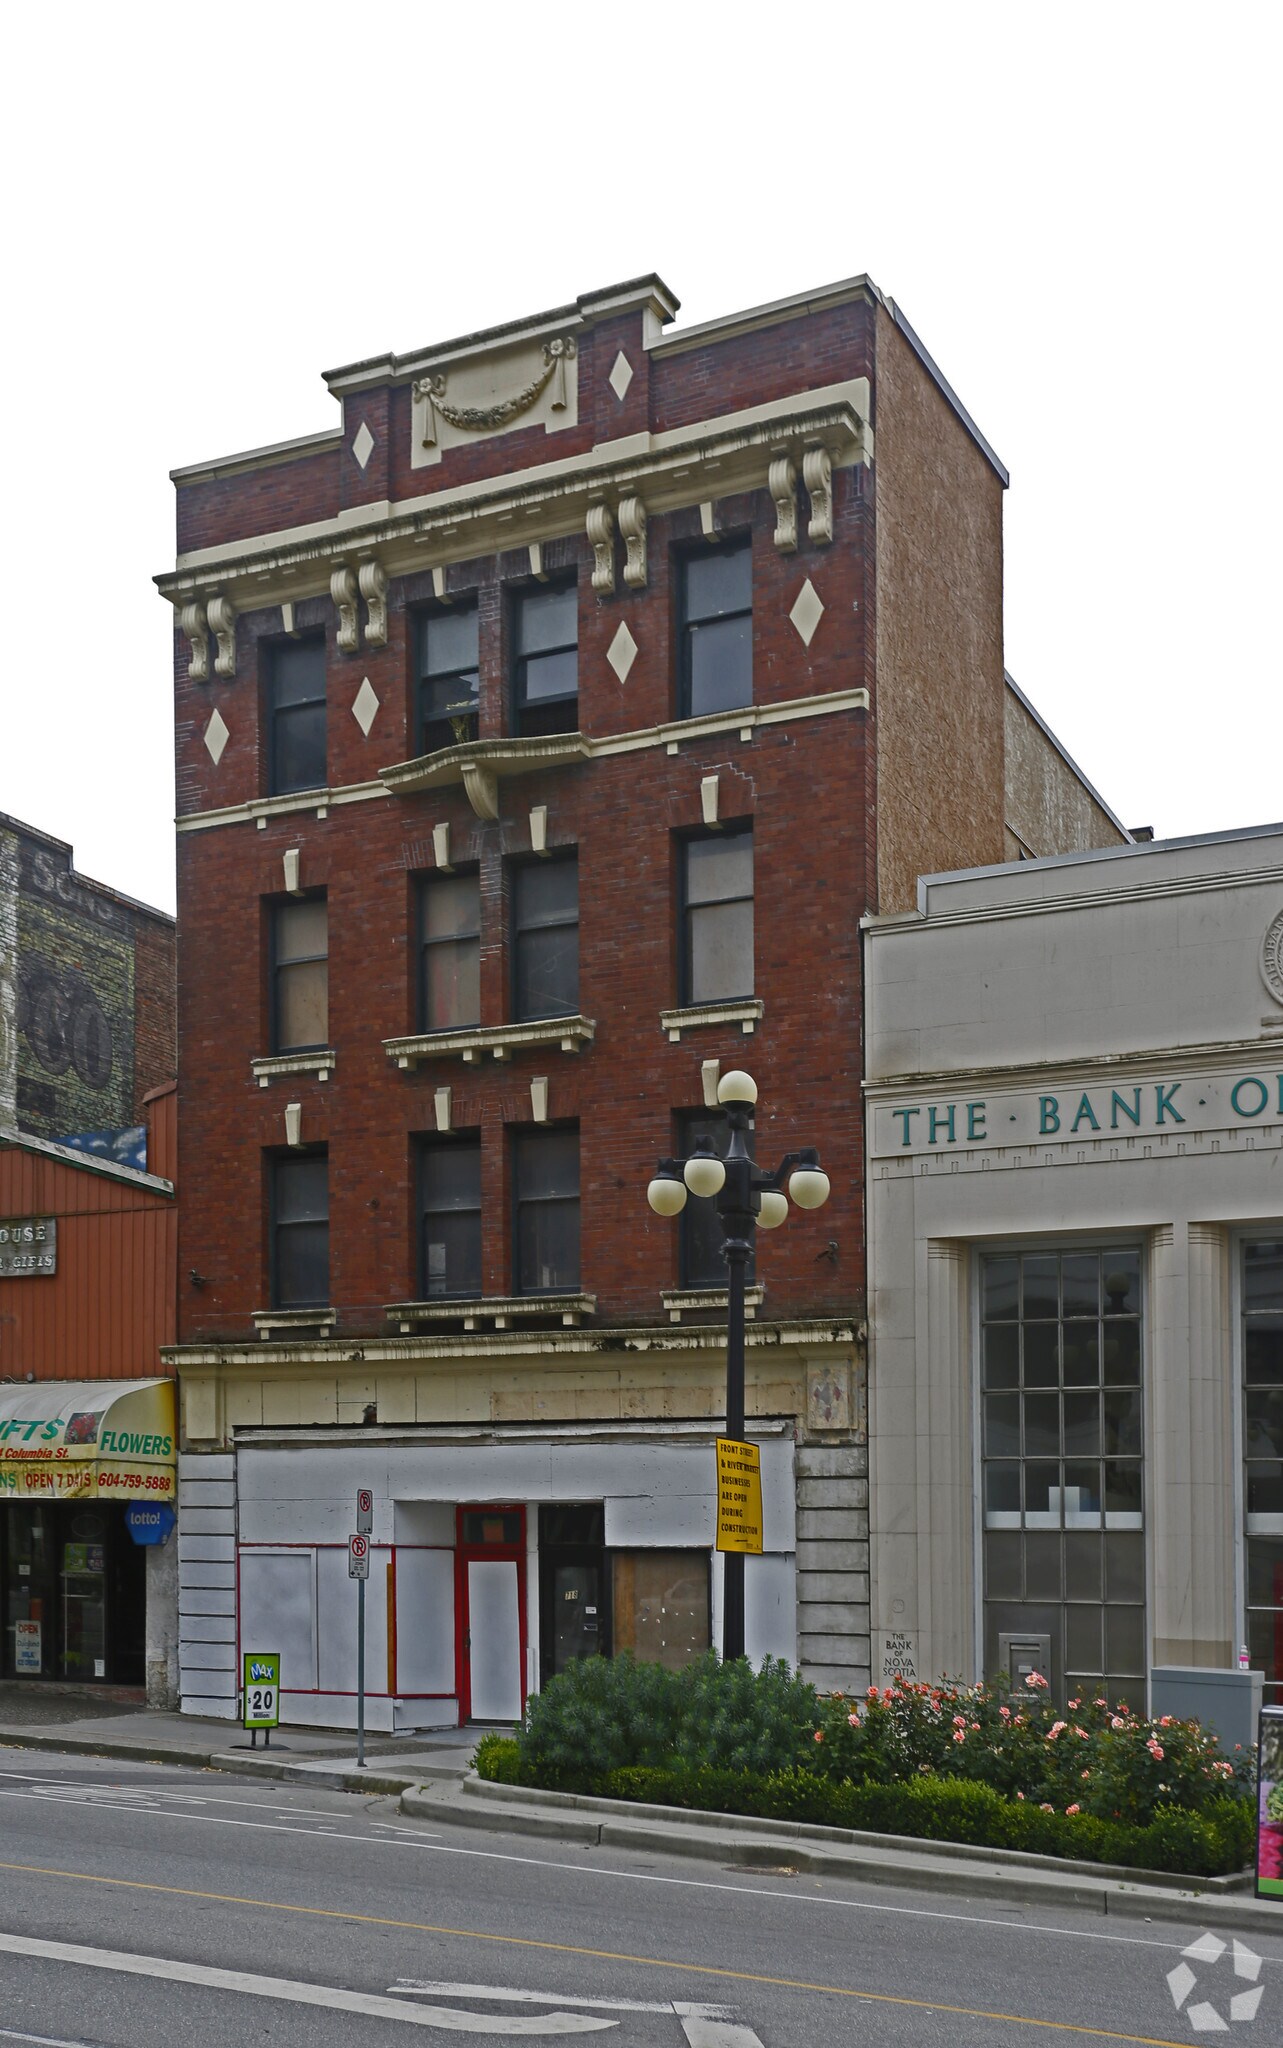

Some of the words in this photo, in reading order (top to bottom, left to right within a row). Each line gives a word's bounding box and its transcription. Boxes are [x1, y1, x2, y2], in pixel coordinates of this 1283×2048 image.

[892, 1101, 988, 1146] THE
[1038, 1083, 1187, 1135] BANK
[1231, 1073, 1283, 1117] O
[100, 1431, 173, 1456] FLOWERS
[720, 1443, 739, 1455] FRONT
[5, 1447, 53, 1459] Columbia
[55, 1447, 70, 1459] St.
[25, 1473, 54, 1488] OPEN
[57, 1473, 63, 1488] 7
[98, 1472, 171, 1491] 604-759-5888
[721, 1491, 733, 1501] ARE
[733, 1493, 748, 1503] OPEN
[130, 1512, 161, 1525] lotto!
[721, 1507, 743, 1518] DURING
[721, 1523, 758, 1535] CONSTRUCTION
[18, 1624, 39, 1634] OPEN
[886, 1640, 912, 1650] BANK
[885, 1658, 914, 1667] NOVA
[251, 1663, 273, 1680] MAX
[883, 1667, 916, 1677] SCOTIA
[253, 1691, 273, 1709] 20
